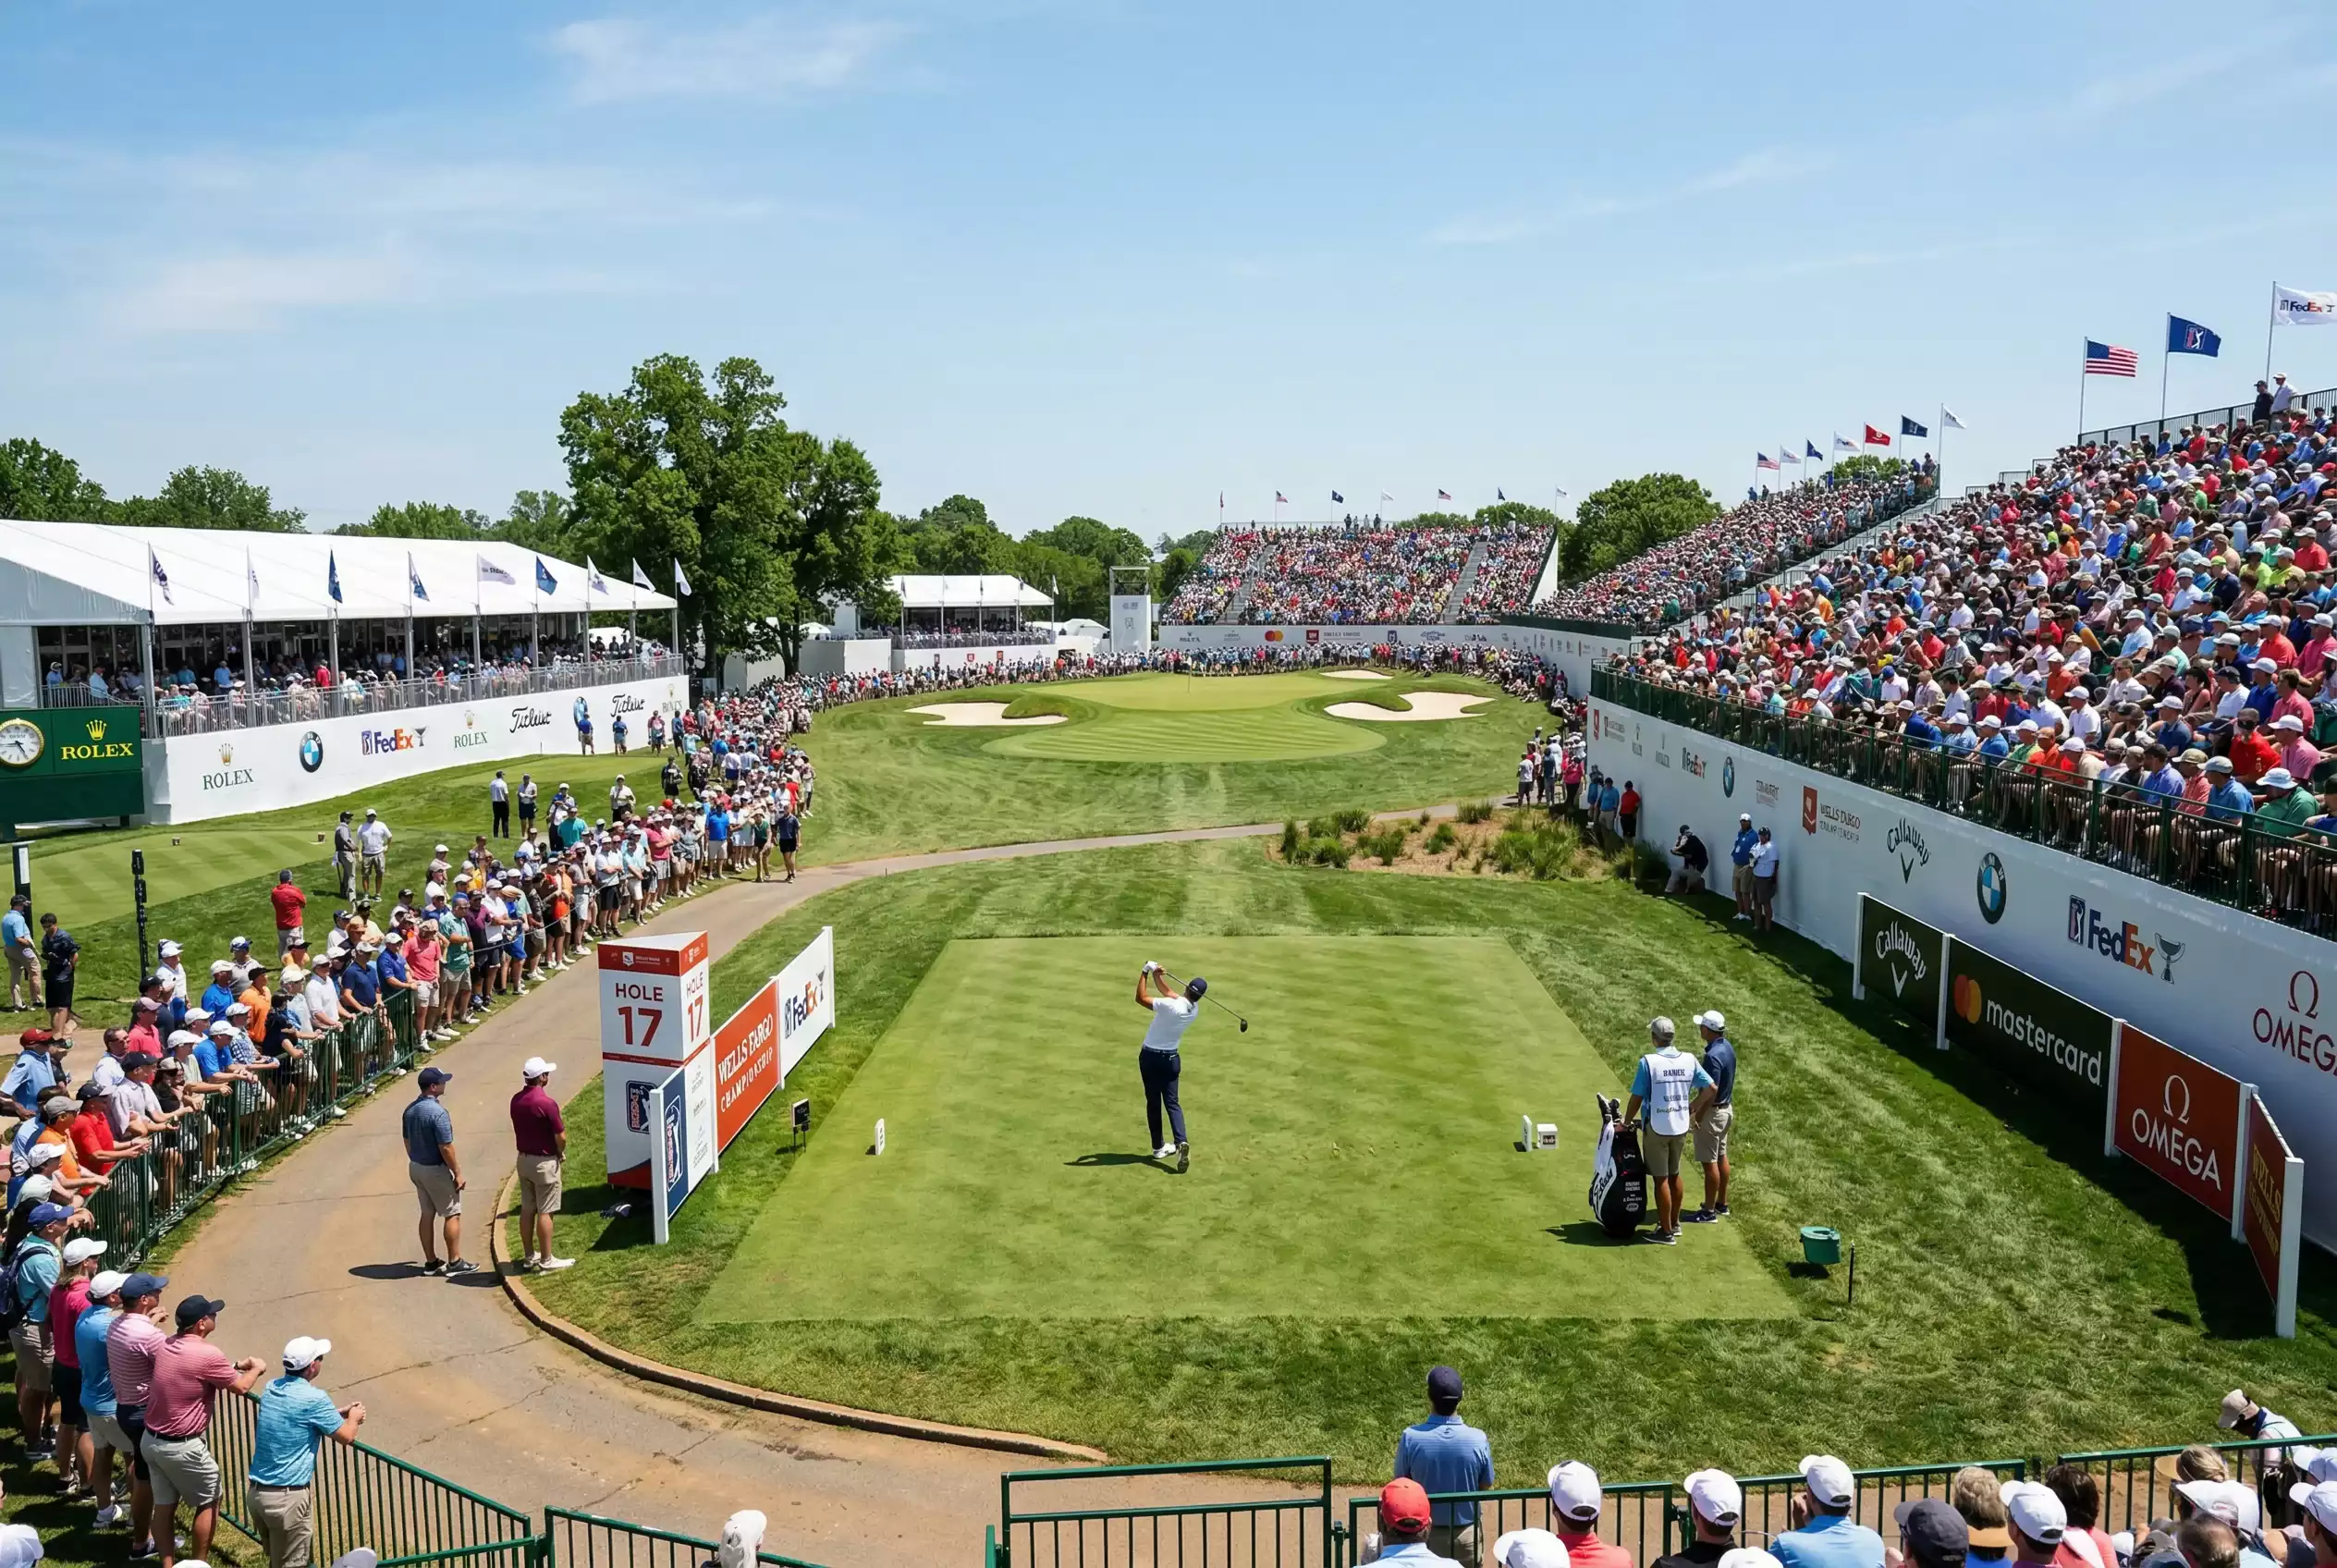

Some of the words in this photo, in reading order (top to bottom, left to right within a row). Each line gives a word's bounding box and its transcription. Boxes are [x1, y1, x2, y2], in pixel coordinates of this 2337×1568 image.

[2290, 300, 2322, 312] FedEx
[60, 742, 135, 760] ROLEX
[373, 729, 414, 754] FedEx
[454, 731, 488, 748] ROLEX
[202, 768, 254, 790] ROLEX
[1887, 817, 1930, 867] Callaway
[1876, 920, 1927, 981] Callaway
[2087, 908, 2156, 976] FedEx
[615, 982, 664, 1002] HOLE
[686, 972, 704, 996] HOLE
[792, 981, 818, 1031] FedEx
[618, 1006, 663, 1047] 17
[687, 994, 704, 1043] 17
[1987, 998, 2102, 1086] mastercard
[2253, 1007, 2337, 1078] OMEG
[718, 1038, 748, 1086] WELLS
[748, 1013, 773, 1057] FARGO
[2132, 1108, 2221, 1192] OMEGA
